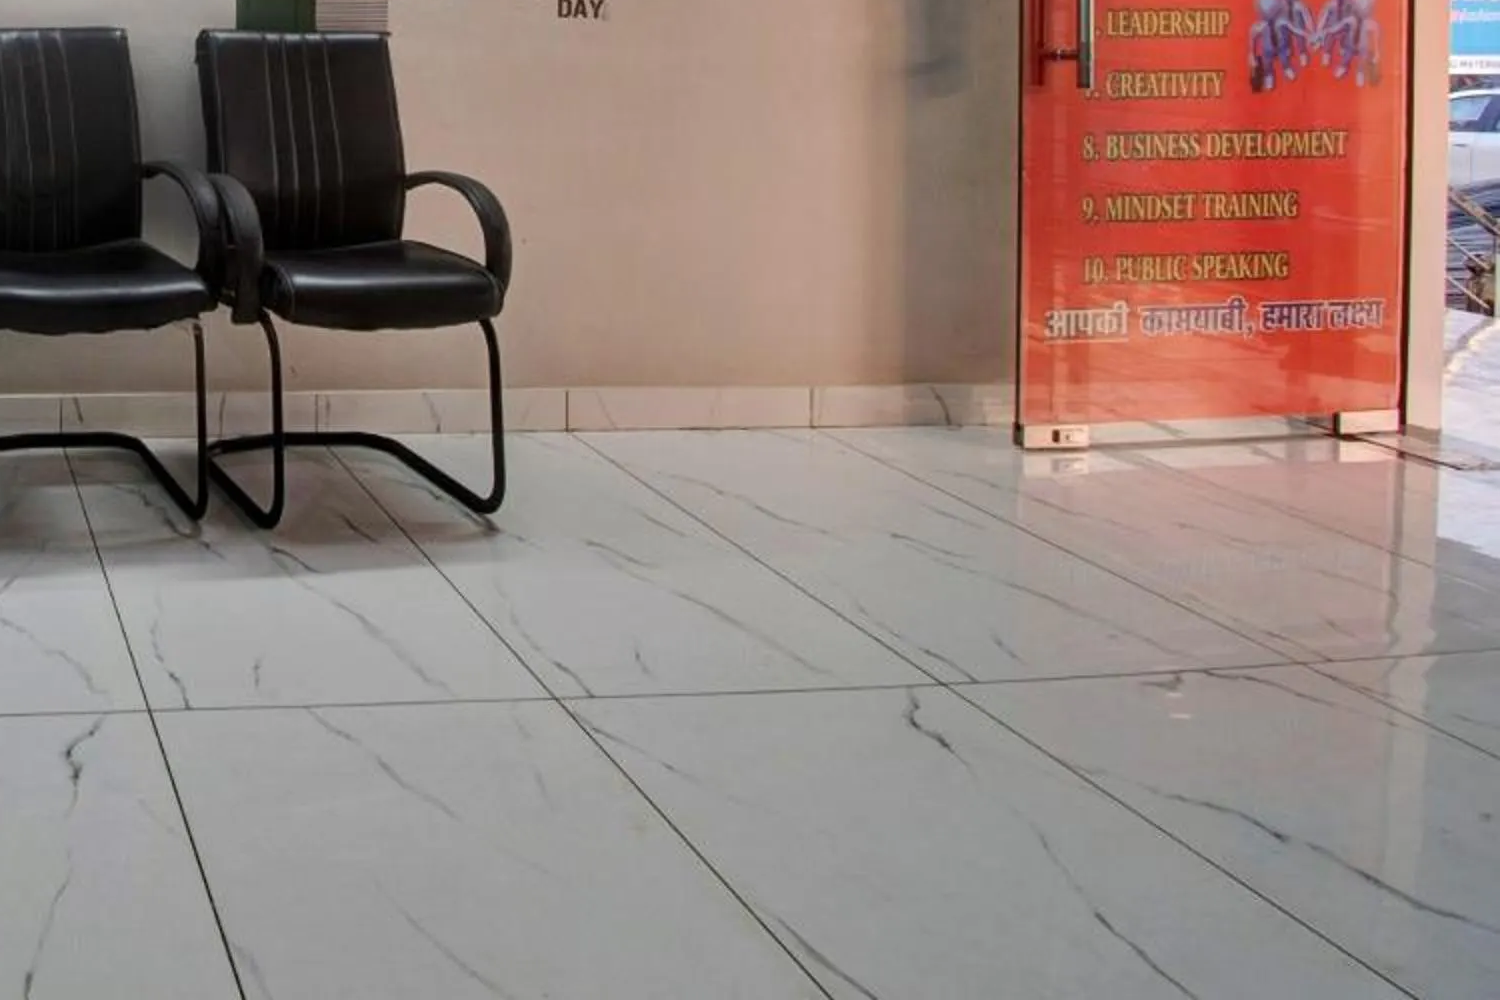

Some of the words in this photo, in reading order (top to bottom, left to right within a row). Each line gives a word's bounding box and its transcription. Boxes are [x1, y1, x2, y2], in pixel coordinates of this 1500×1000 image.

[1106, 9, 1231, 37] LEADERSHIP
[1104, 70, 1225, 98] CREATIVITY
[1082, 134, 1100, 160] 8.
[1106, 131, 1201, 159] BUSINESS
[1206, 129, 1349, 158] DEVELOPMENT
[1081, 196, 1100, 221] 9.
[1105, 193, 1197, 220] MINDSET
[1201, 190, 1299, 218] TRAINING
[1083, 257, 1109, 283] 10.
[1115, 254, 1189, 281] PUBLIC
[1191, 252, 1291, 280] SPEAKING
[1043, 300, 1130, 338] आपकी
[1258, 300, 1324, 332] हमारा
[1325, 298, 1385, 330] लक्ष्य
